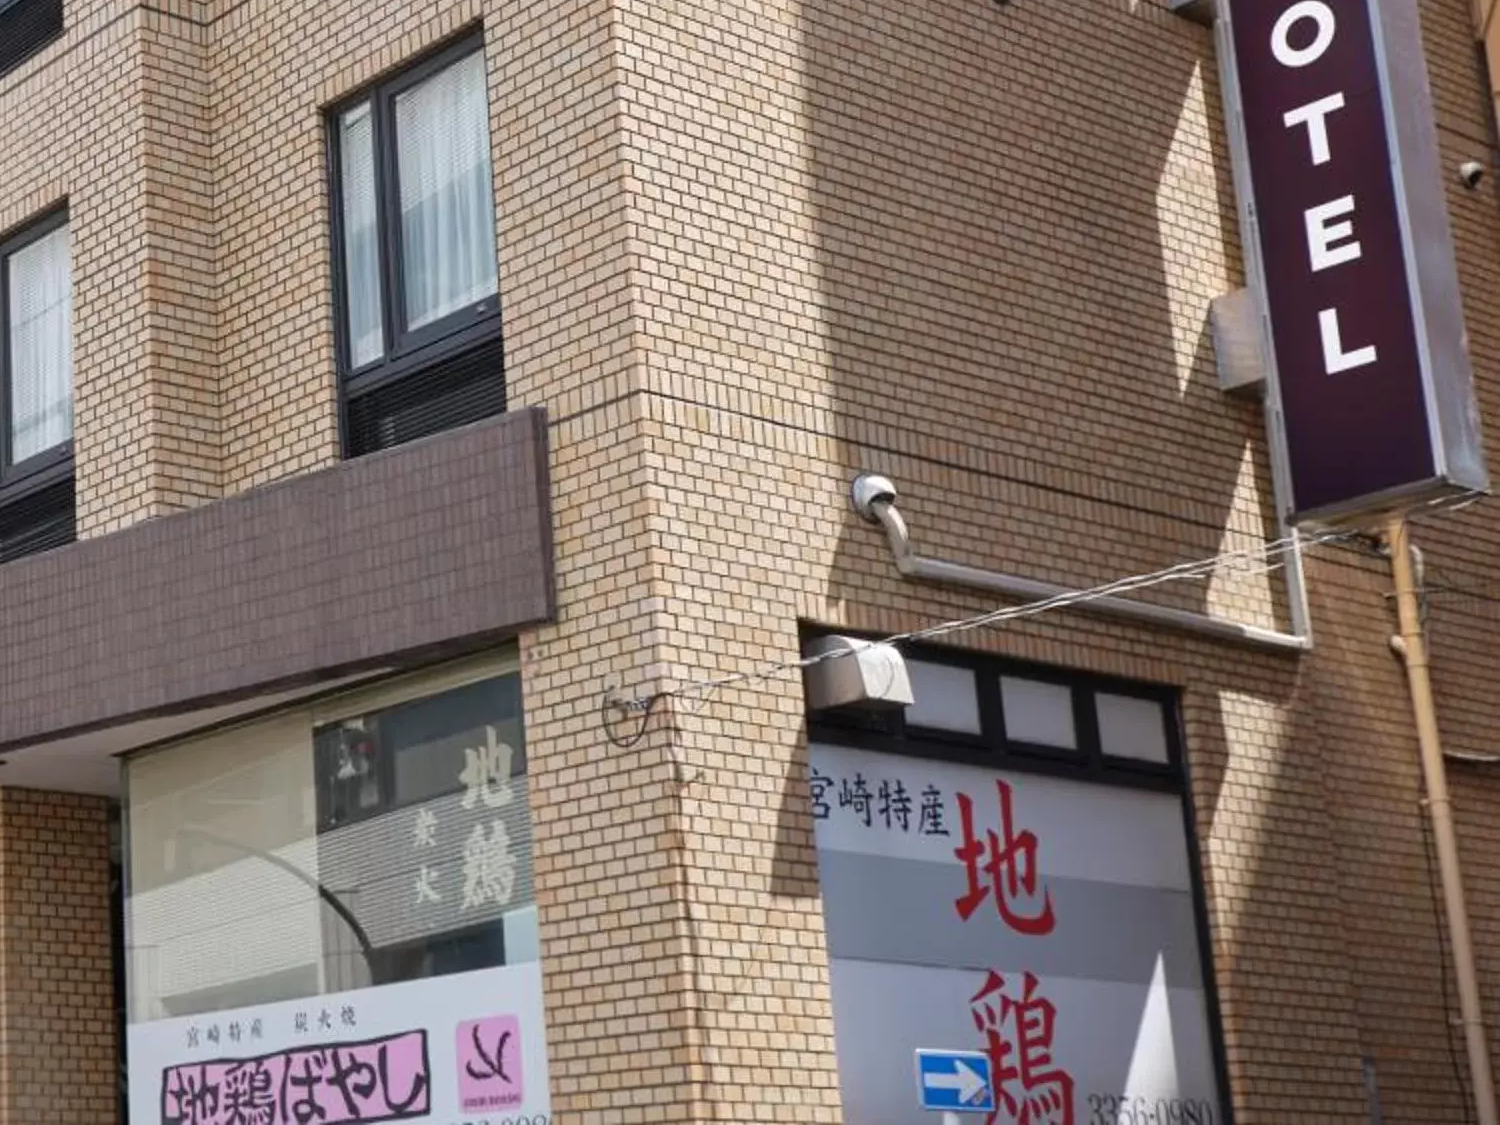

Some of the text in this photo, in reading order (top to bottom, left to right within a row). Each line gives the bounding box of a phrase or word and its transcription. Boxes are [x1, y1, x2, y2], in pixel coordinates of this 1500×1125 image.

[810, 767, 950, 836] 宮崎特産
[953, 780, 1076, 1125] 地鶏
[169, 1045, 426, 1125] 地鶏ばやし
